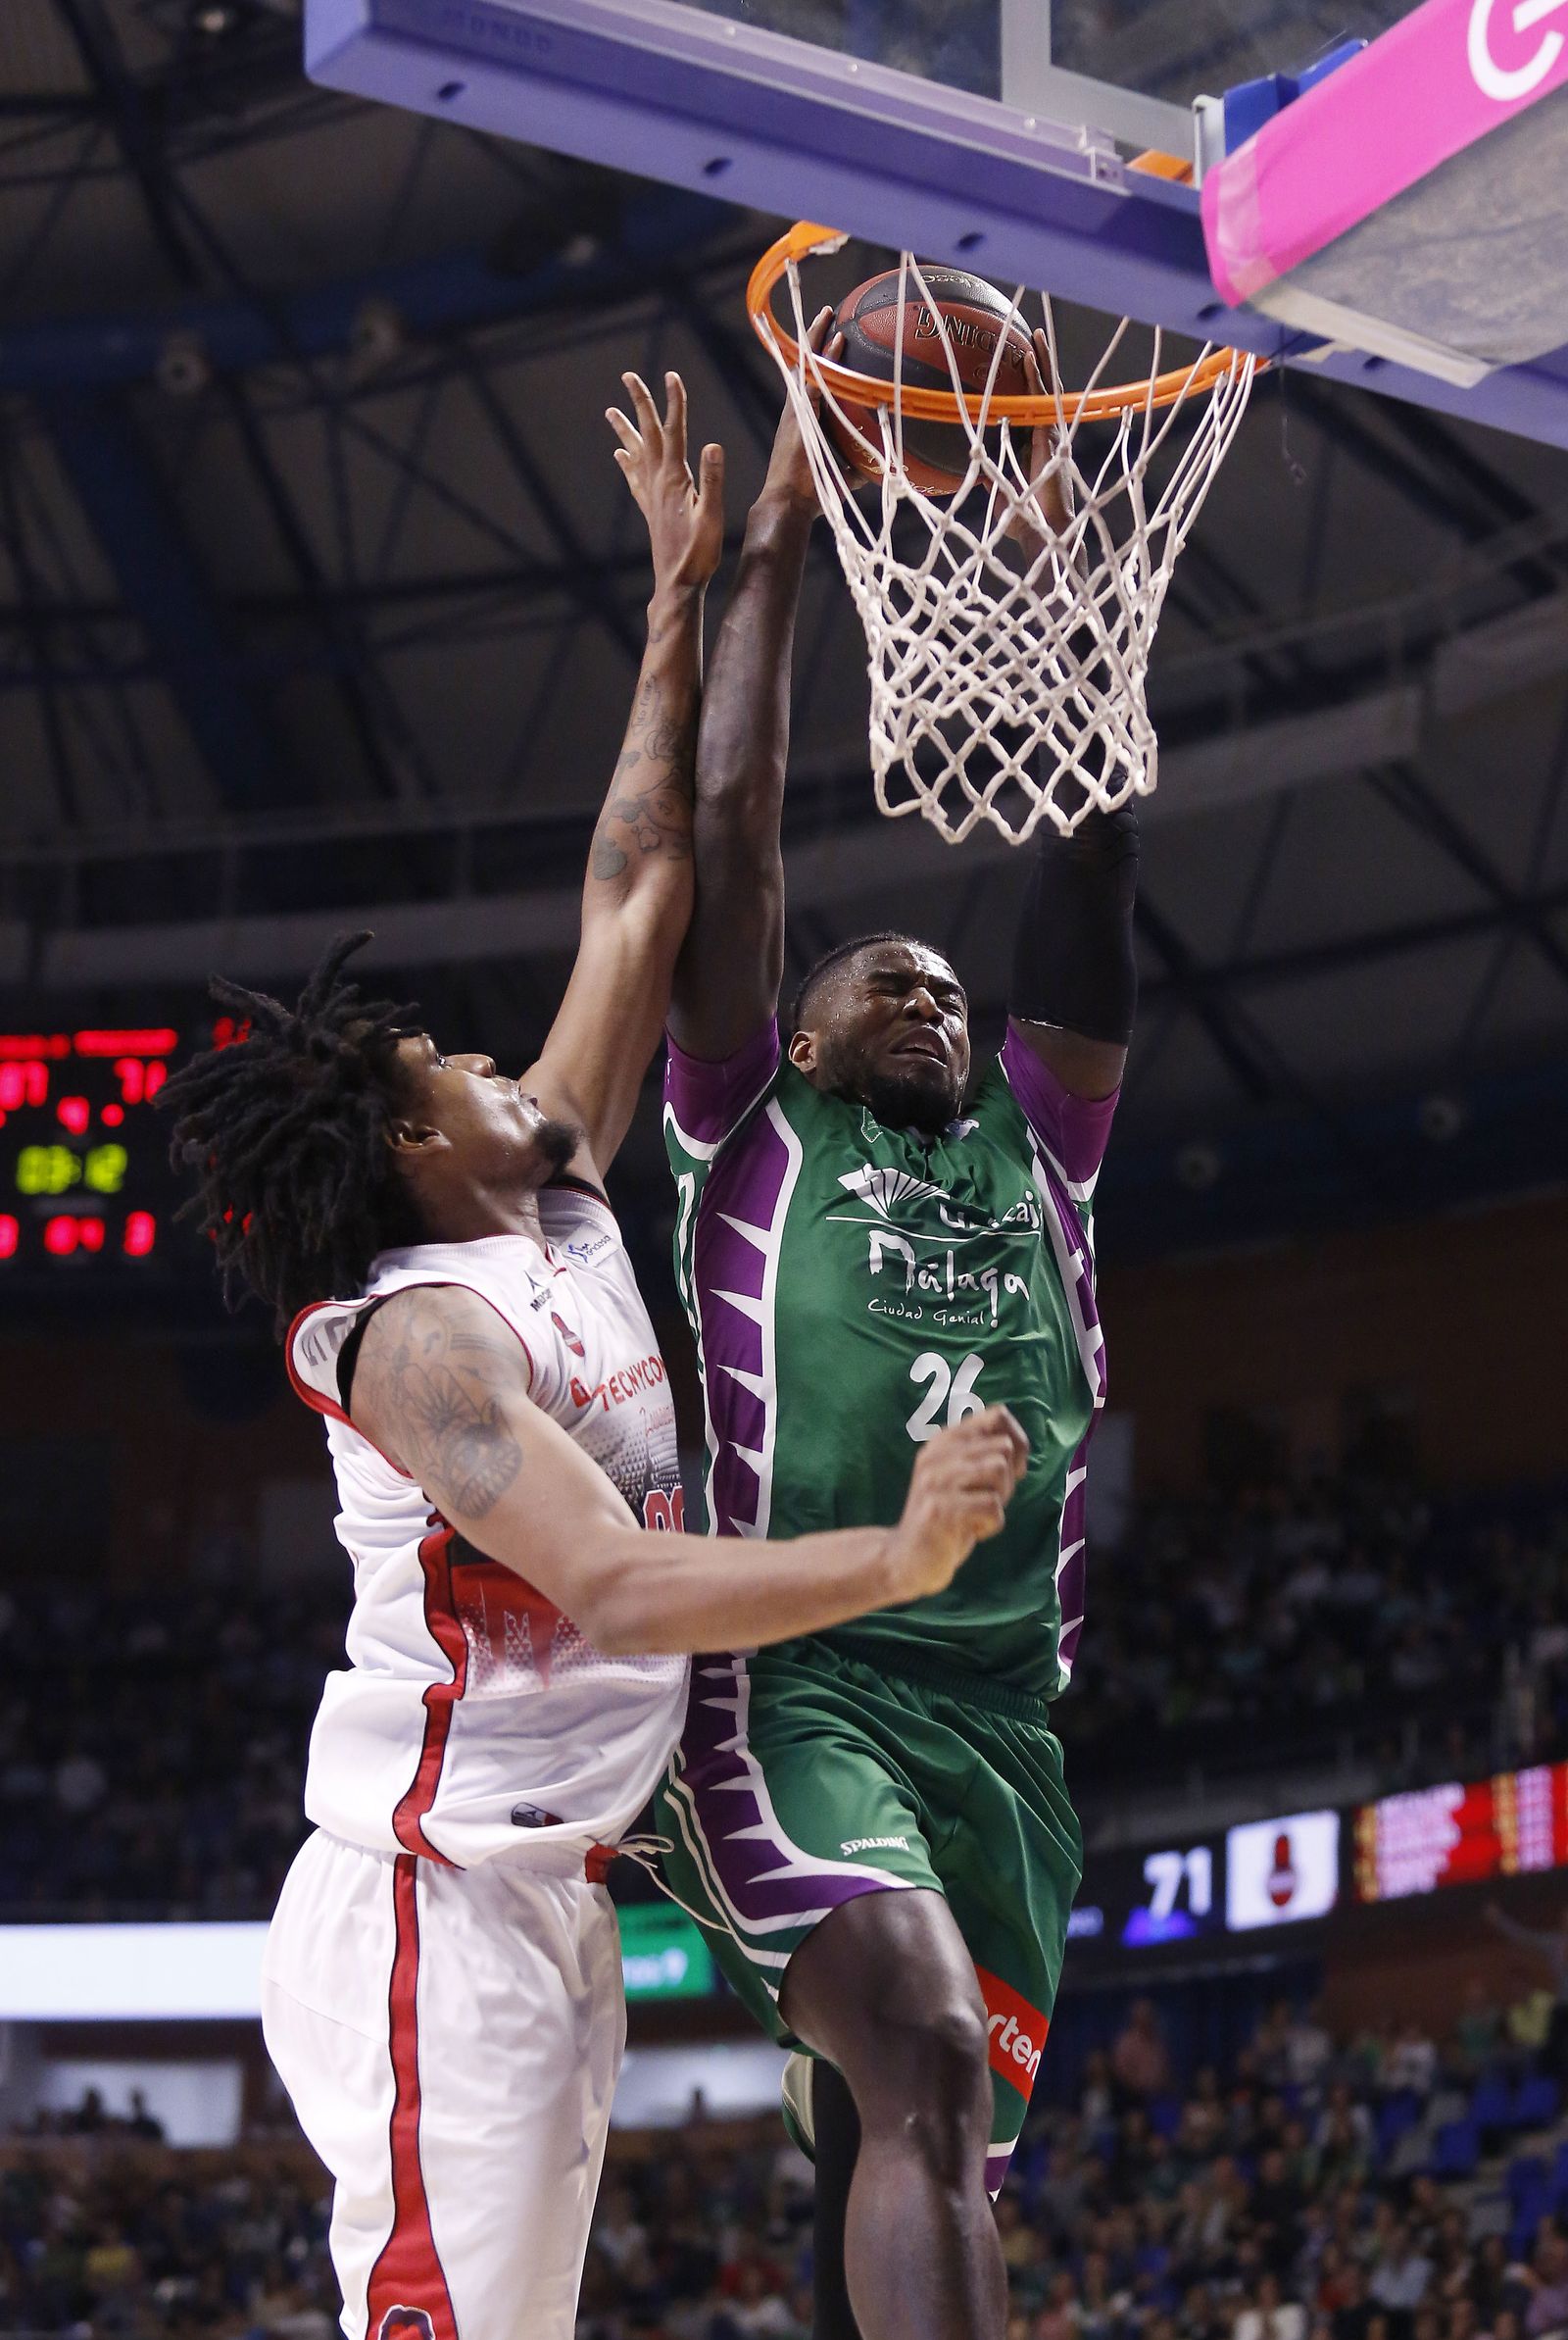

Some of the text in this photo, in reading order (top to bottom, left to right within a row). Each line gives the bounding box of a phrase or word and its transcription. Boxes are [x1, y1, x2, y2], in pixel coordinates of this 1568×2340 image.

[867, 1298, 923, 1320] Ciudad
[905, 1351, 987, 1443] 26
[840, 1835, 910, 1857] SPALDING
[1143, 1845, 1212, 1919] 71
